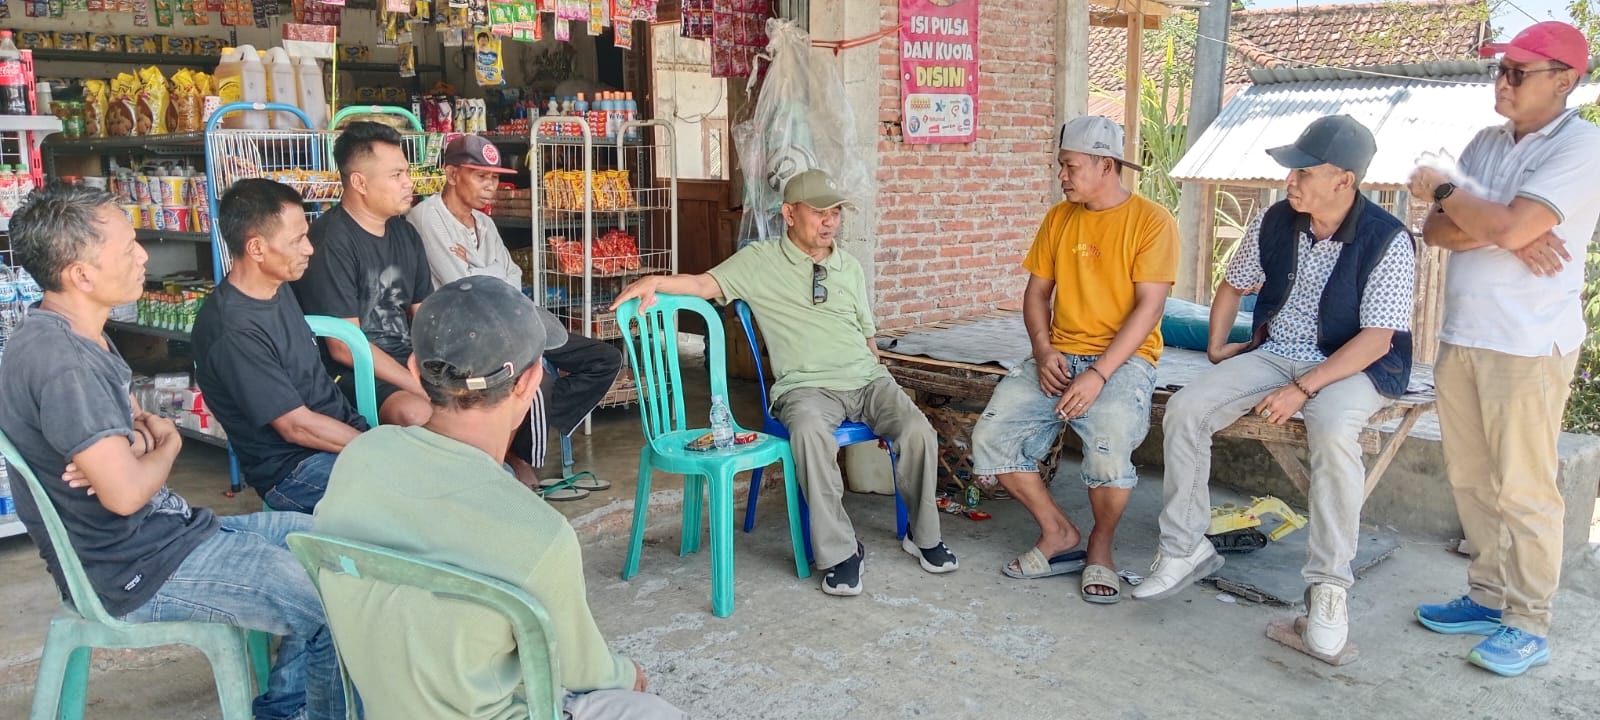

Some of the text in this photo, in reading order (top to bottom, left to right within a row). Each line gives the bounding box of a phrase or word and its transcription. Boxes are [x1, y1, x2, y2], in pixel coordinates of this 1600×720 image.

[911, 16, 969, 36] ISI PULSA
[903, 41, 974, 60] DAN KUOTA
[916, 66, 965, 88] DISINI
